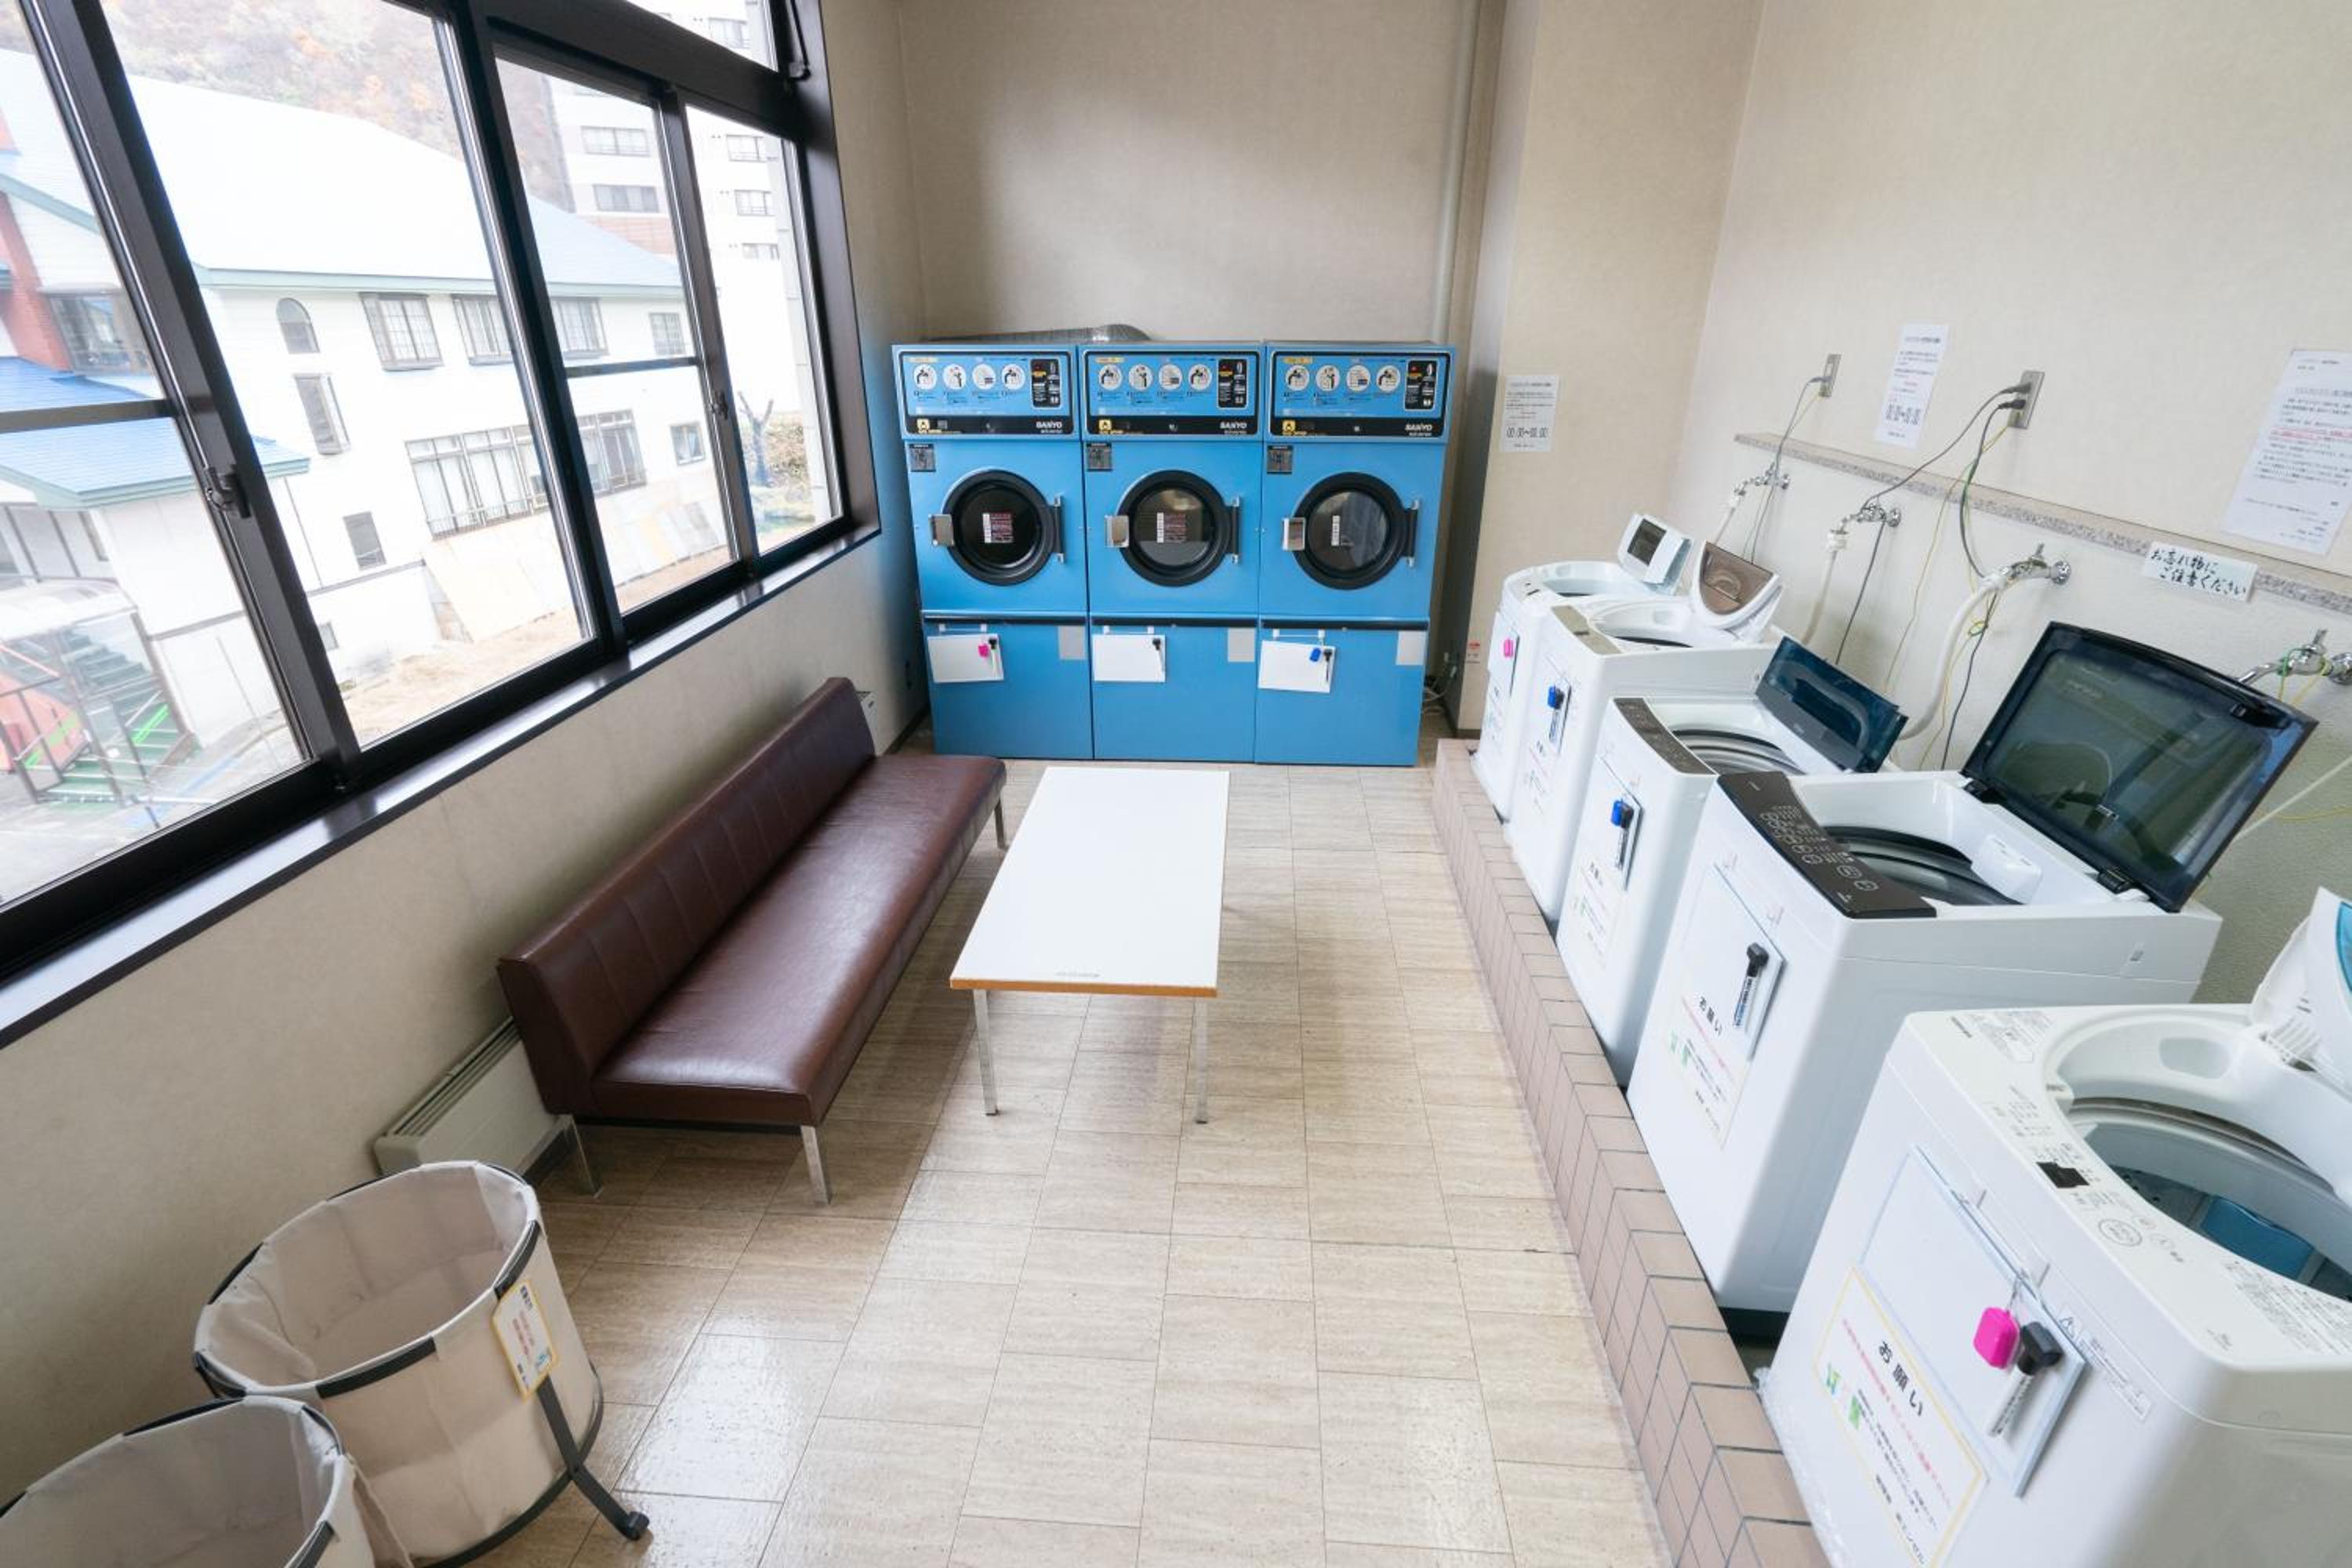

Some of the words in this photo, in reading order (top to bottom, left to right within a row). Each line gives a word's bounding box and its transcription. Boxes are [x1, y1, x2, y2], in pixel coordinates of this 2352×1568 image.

[1036, 419, 1062, 428] SANYO
[1878, 1340, 1923, 1417] お願い
